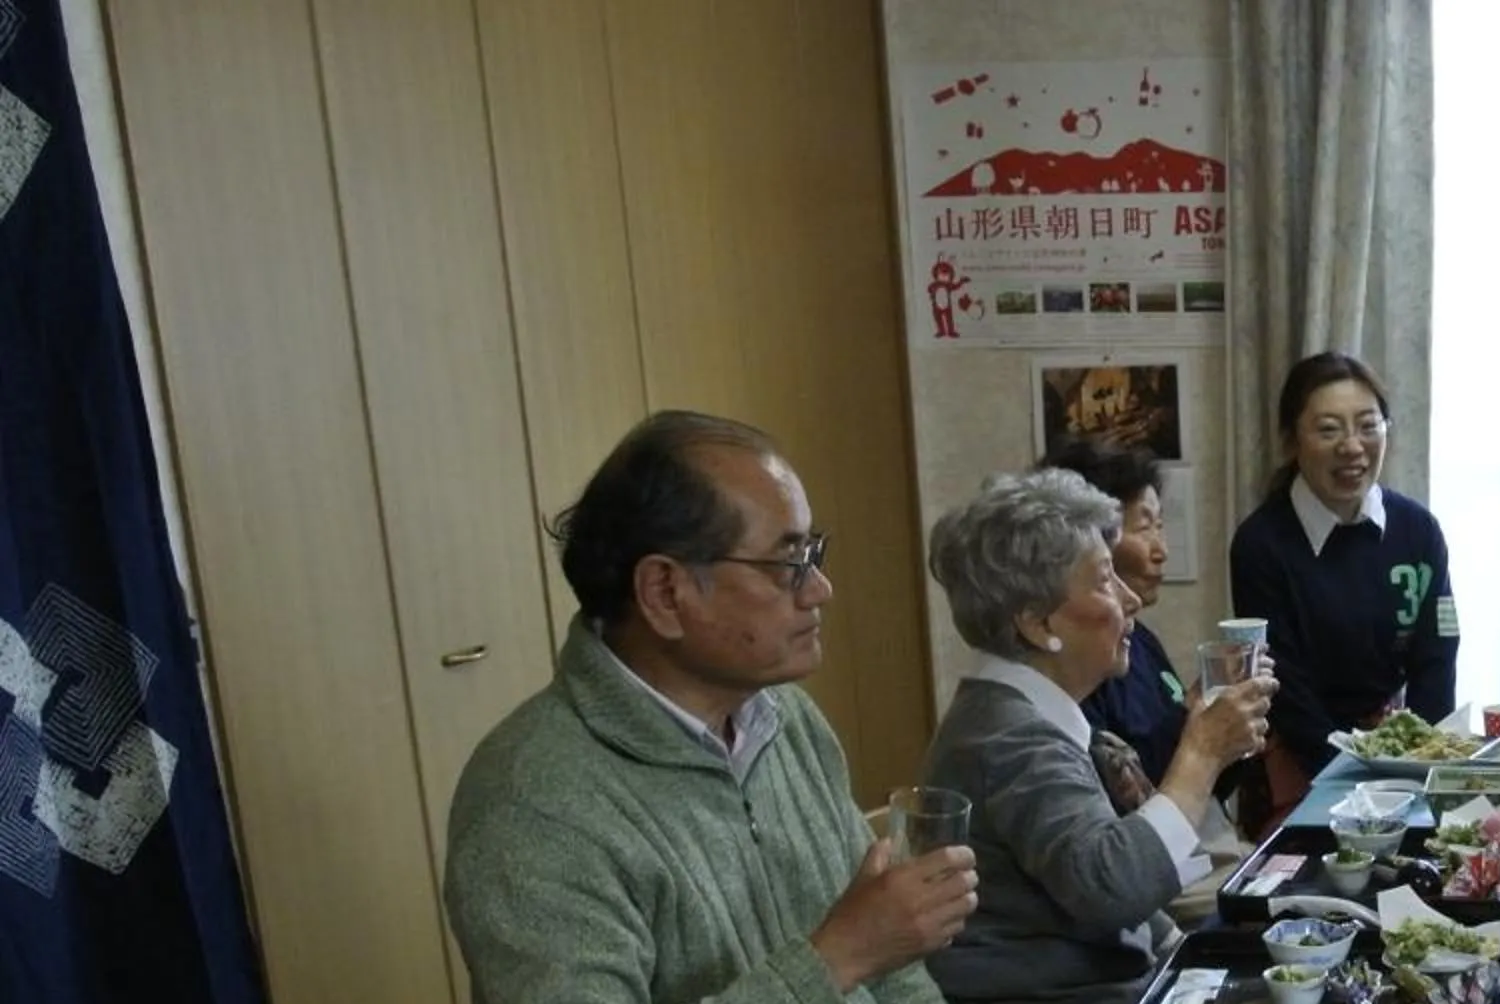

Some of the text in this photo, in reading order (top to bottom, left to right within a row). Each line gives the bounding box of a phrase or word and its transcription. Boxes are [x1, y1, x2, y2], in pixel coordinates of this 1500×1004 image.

[934, 204, 1158, 241] 山形県朝日町
